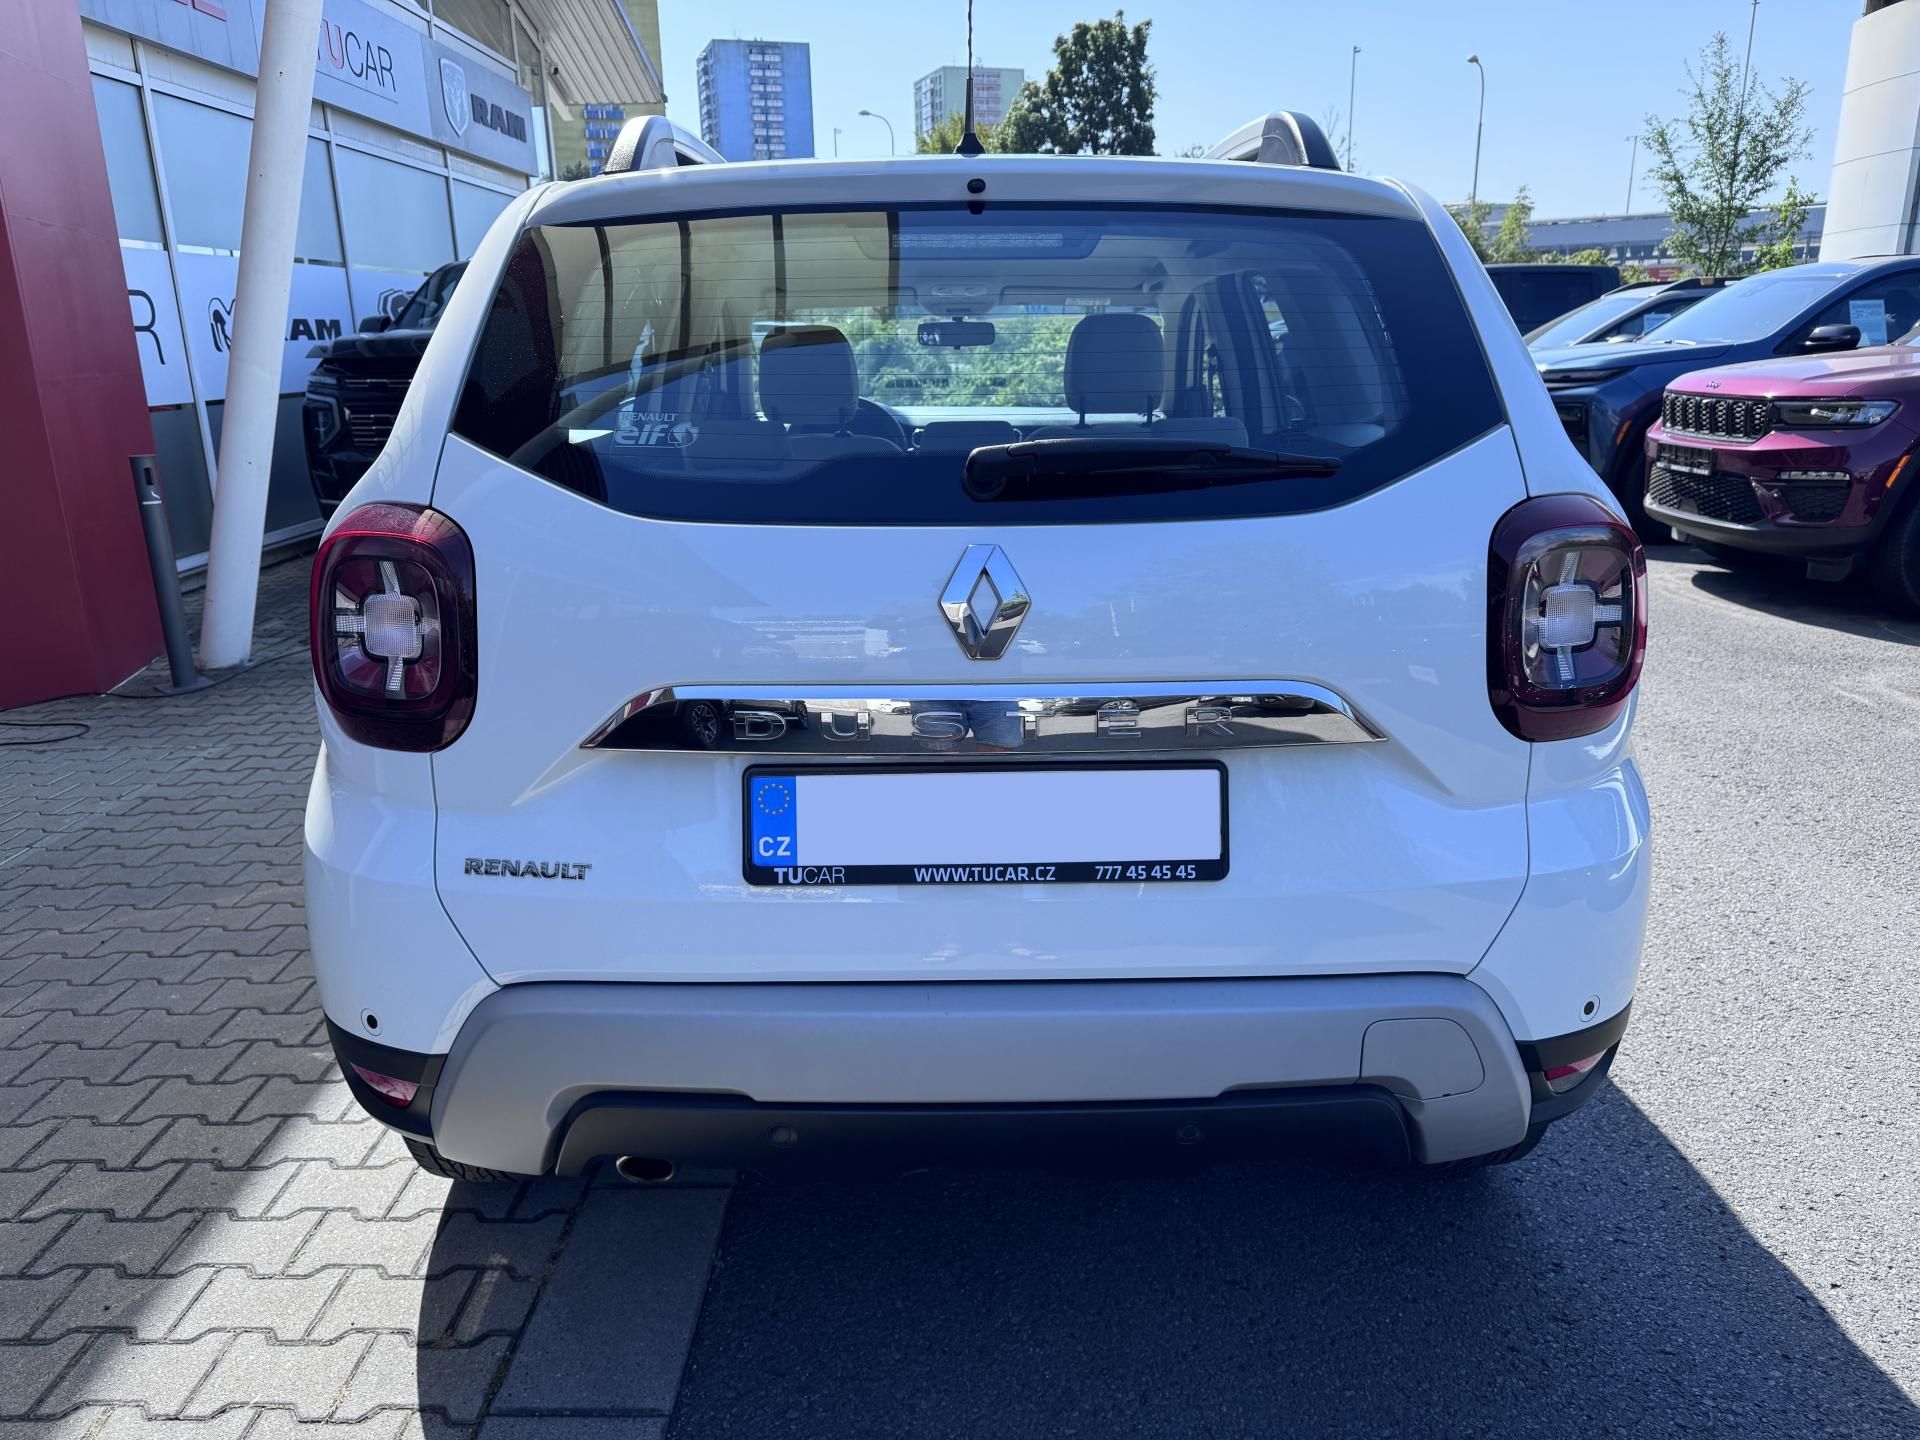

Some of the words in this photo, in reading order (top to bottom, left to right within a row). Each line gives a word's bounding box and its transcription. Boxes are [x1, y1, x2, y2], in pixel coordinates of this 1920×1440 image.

[318, 18, 396, 92] UCAR
[470, 92, 527, 143] RAM
[285, 318, 342, 341] AM
[734, 706, 1234, 741] DUSTER
[758, 836, 791, 857] CZ
[464, 857, 592, 880] RENAULT
[774, 867, 845, 884] TUCAR
[914, 866, 1056, 882] WWW.TUCAR.CZ
[1095, 865, 1122, 880] 777
[1126, 865, 1147, 880] 45
[1151, 864, 1171, 879] 45
[1175, 864, 1196, 879] 45
